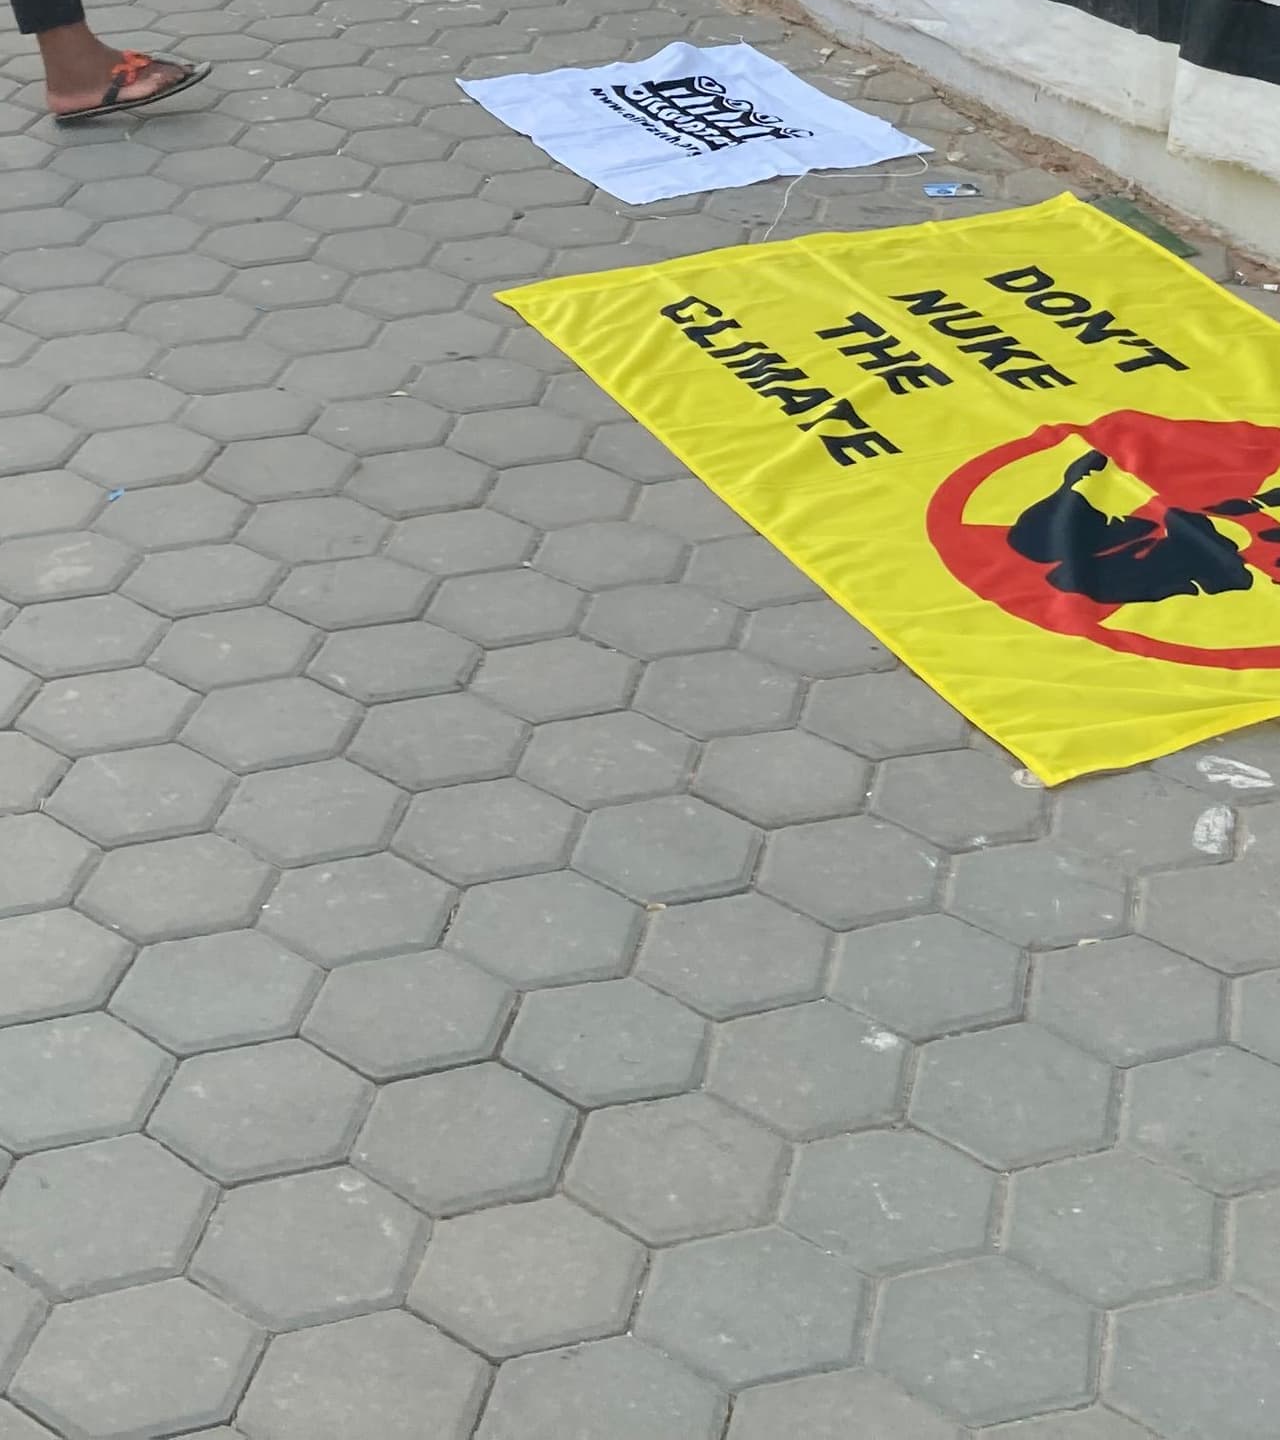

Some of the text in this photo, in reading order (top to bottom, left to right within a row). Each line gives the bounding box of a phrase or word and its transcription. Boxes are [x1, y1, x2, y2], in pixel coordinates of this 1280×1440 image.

[815, 311, 954, 395] THE
[888, 289, 1078, 391] NUKE
[983, 265, 1190, 374] DON'T
[660, 295, 903, 467] CLIMATE
